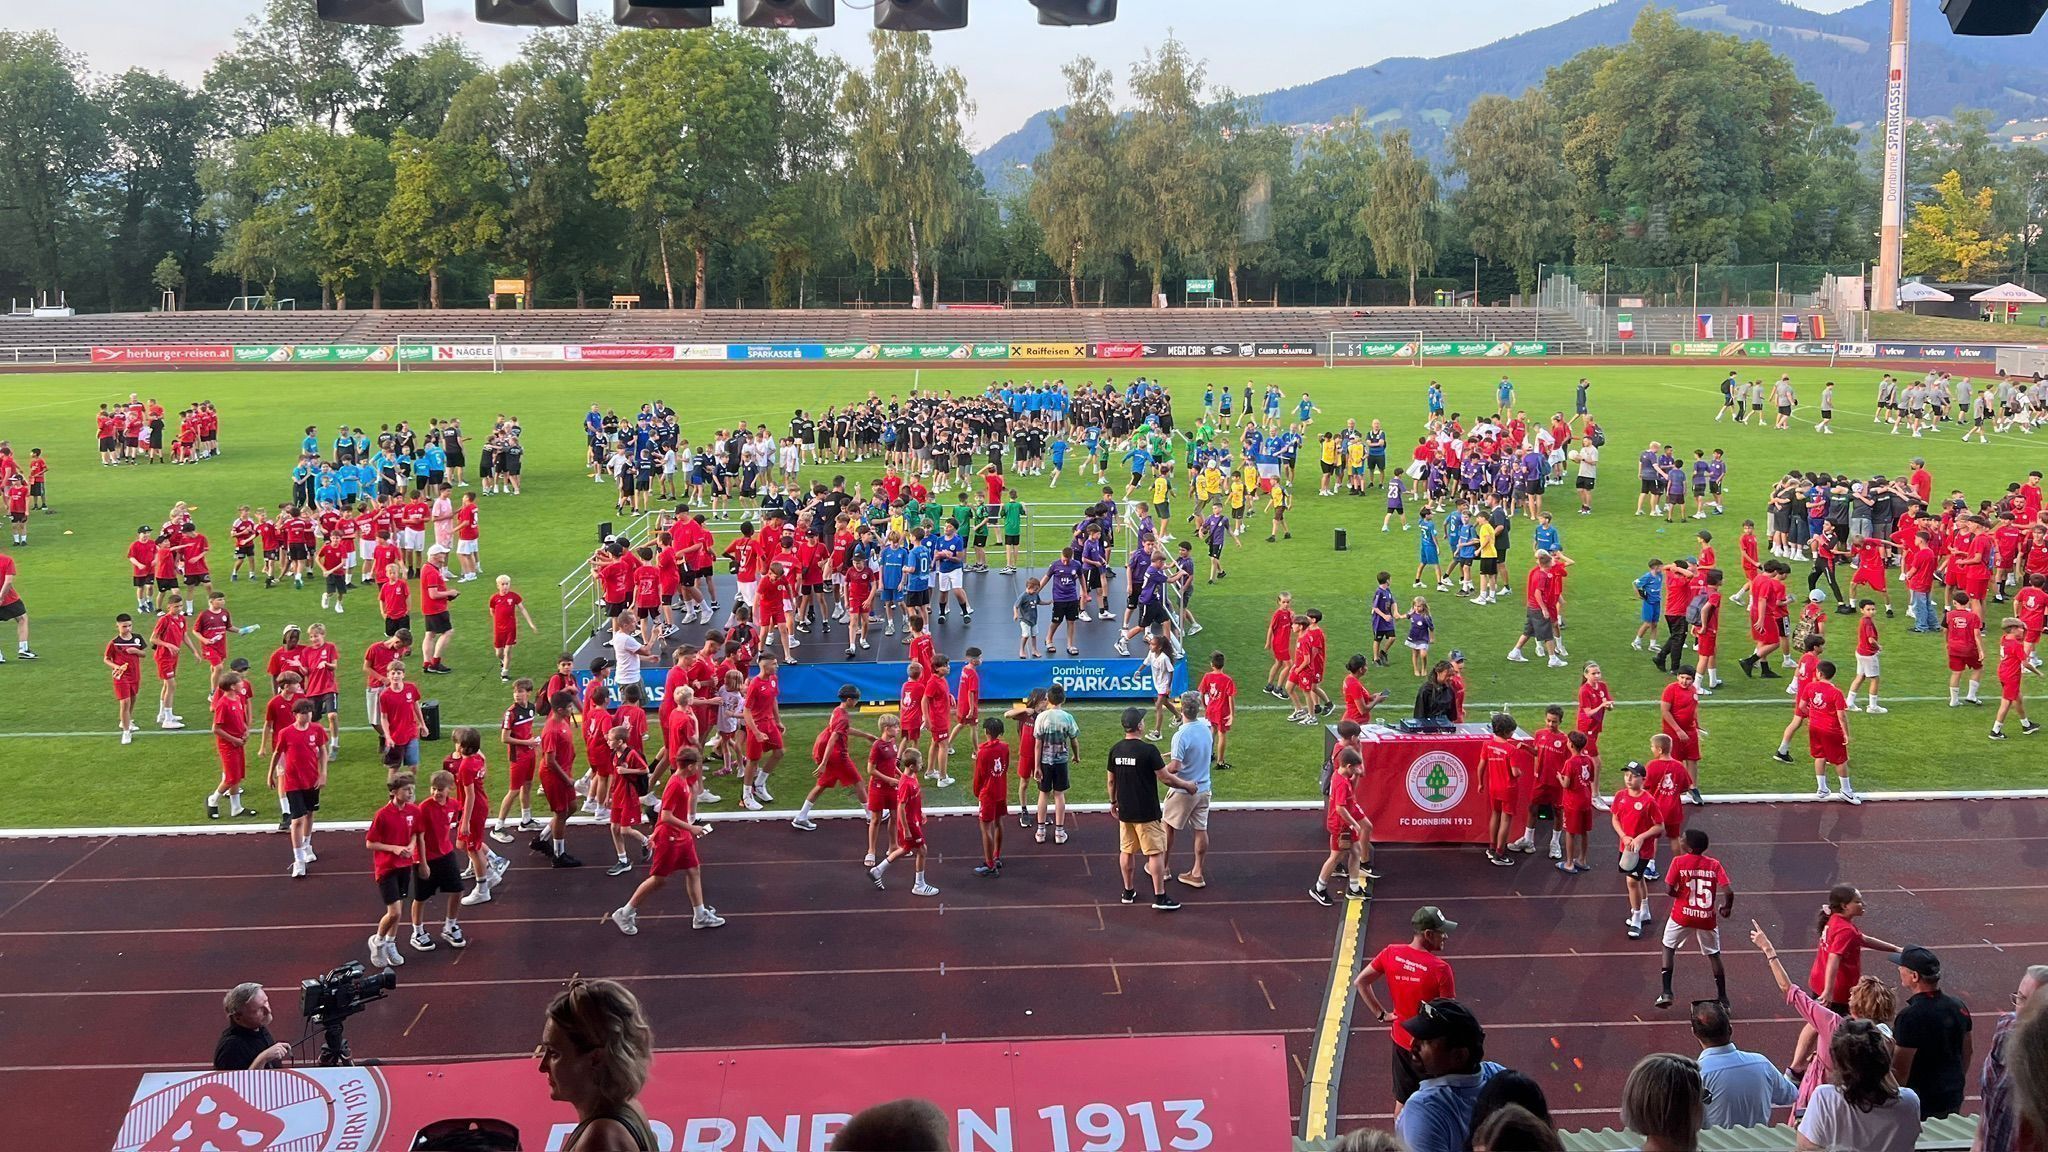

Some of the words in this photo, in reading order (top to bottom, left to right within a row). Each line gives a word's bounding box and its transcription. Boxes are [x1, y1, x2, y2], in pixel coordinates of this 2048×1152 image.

[1888, 83, 1901, 150] SPARKASSE
[1887, 152, 1898, 202] Dornbirner
[127, 349, 230, 360] herburger-reisen.at
[1026, 347, 1070, 356] Raiffeisen
[1168, 346, 1187, 355] MEGA
[1188, 346, 1206, 355] CARS
[1886, 347, 1906, 355] vkw
[1925, 347, 1946, 356] vkw
[1387, 485, 1399, 499] 23
[1052, 666, 1105, 676] Dornbirner
[1052, 676, 1152, 692] SPARKASSE
[1400, 818, 1410, 826] FC
[1411, 818, 1452, 826] DORNBIRN
[1454, 818, 1473, 826] 1913
[1685, 878, 1713, 909] 15
[338, 1079, 367, 1111] 1913
[1038, 1099, 1213, 1152] 1913
